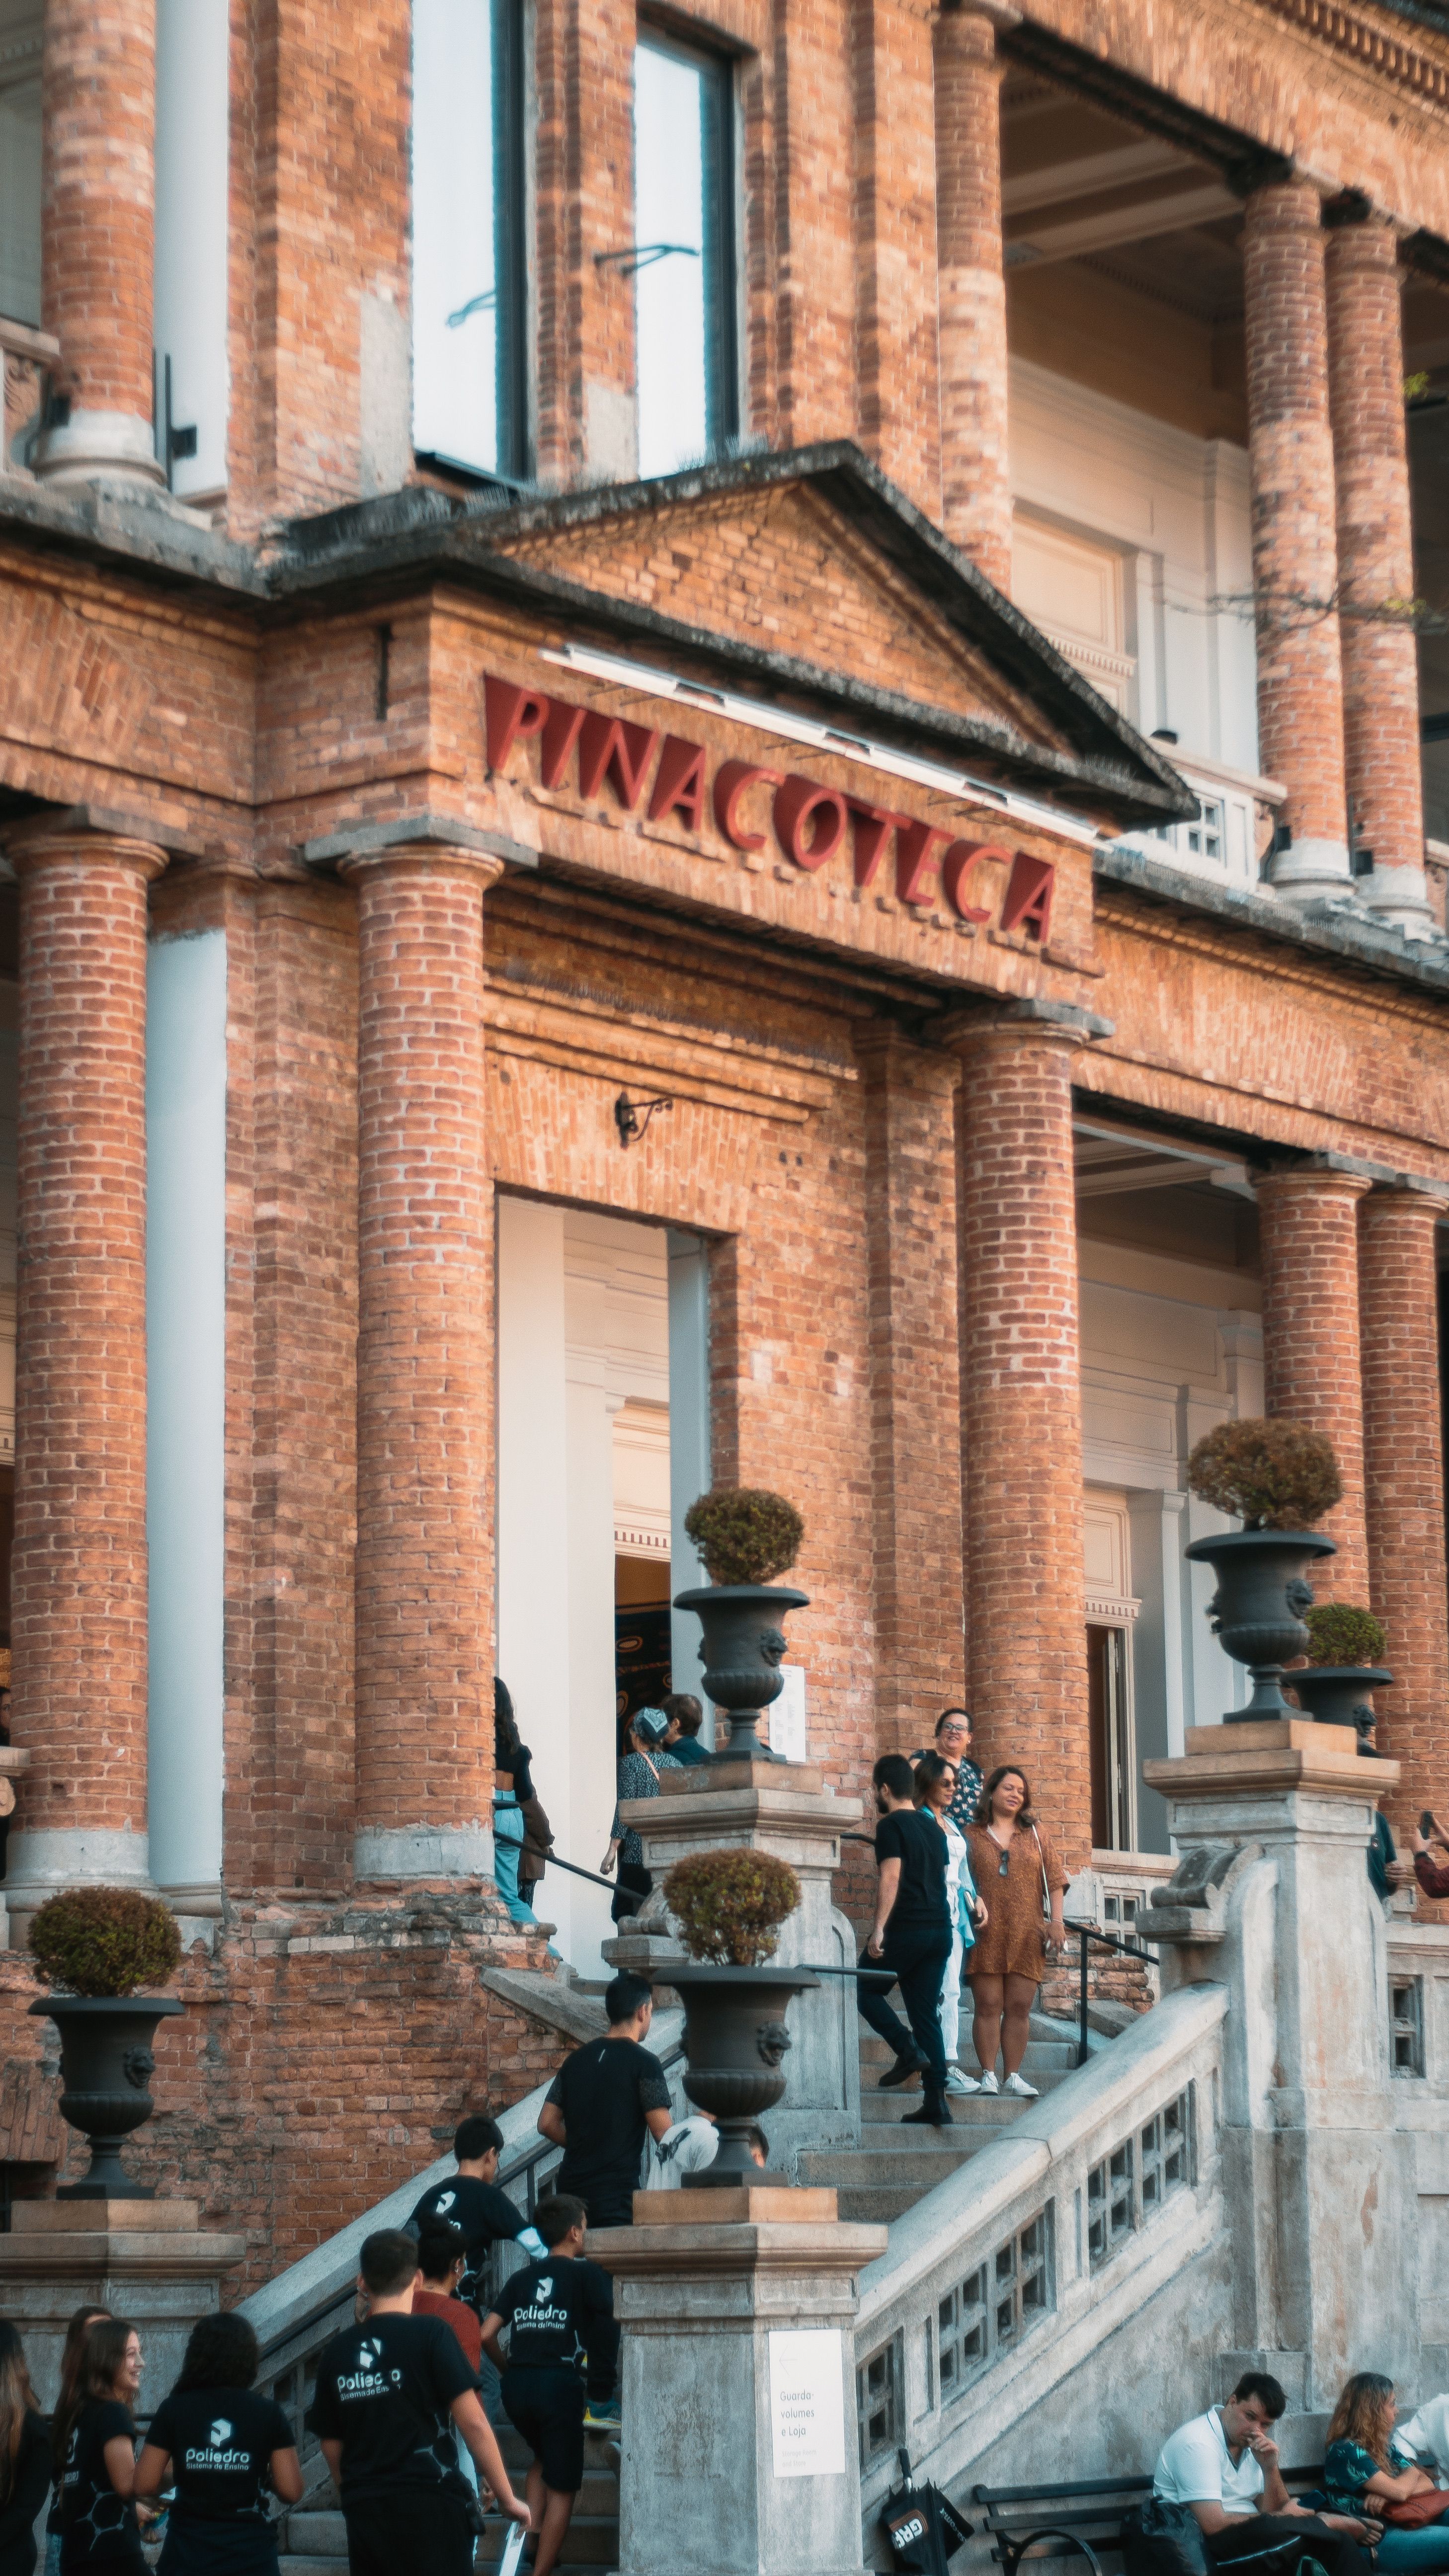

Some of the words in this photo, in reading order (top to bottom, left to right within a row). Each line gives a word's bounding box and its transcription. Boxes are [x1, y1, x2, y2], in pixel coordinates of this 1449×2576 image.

[482, 671, 1055, 943] PINACOTECA
[514, 2304, 567, 2323] Poliedro
[780, 2389, 814, 2402] Guarda-
[781, 2407, 815, 2419] volumes
[781, 2428, 786, 2437] e
[789, 2424, 806, 2438] Loja
[186, 2448, 250, 2463] Poliedro
